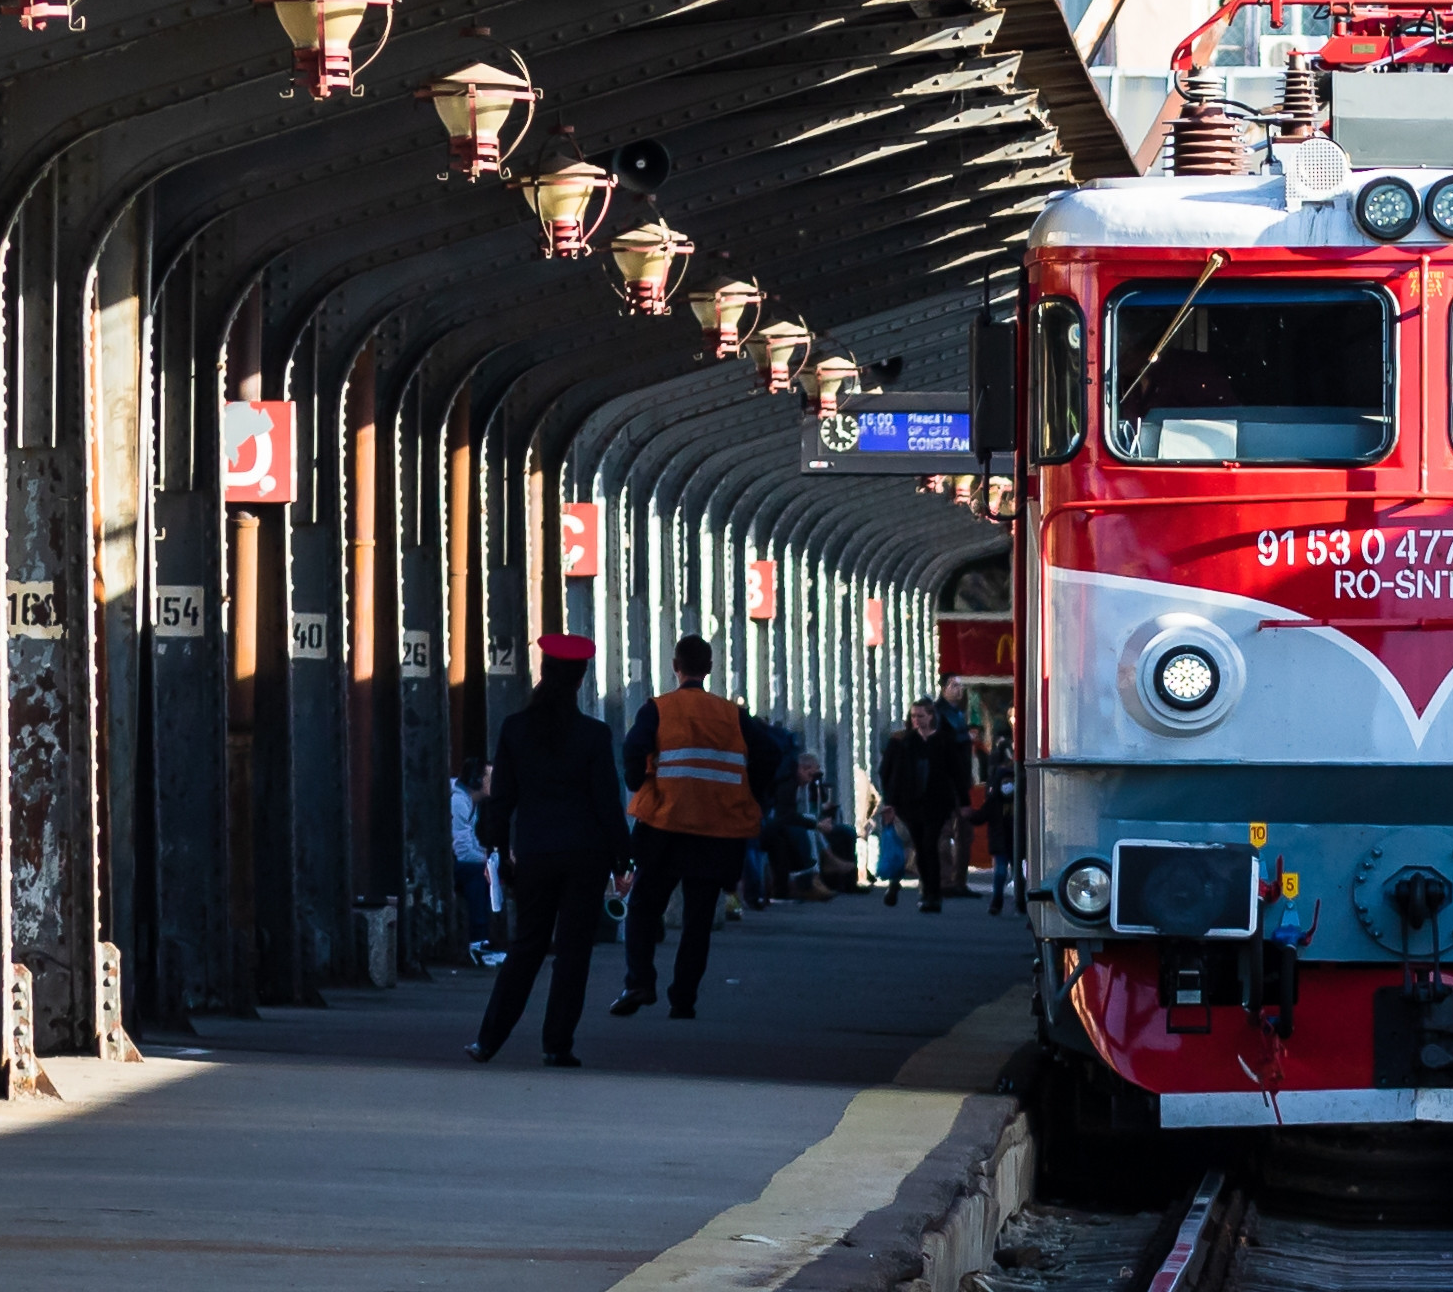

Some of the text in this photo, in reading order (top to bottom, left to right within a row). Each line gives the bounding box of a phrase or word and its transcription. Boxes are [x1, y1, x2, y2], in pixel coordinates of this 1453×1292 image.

[859, 413, 894, 426] 16:00
[1257, 530, 1296, 567] 91
[1306, 530, 1352, 567] 53
[1362, 529, 1386, 566] 0
[1250, 826, 1266, 840] 10
[1286, 877, 1295, 892] 5
